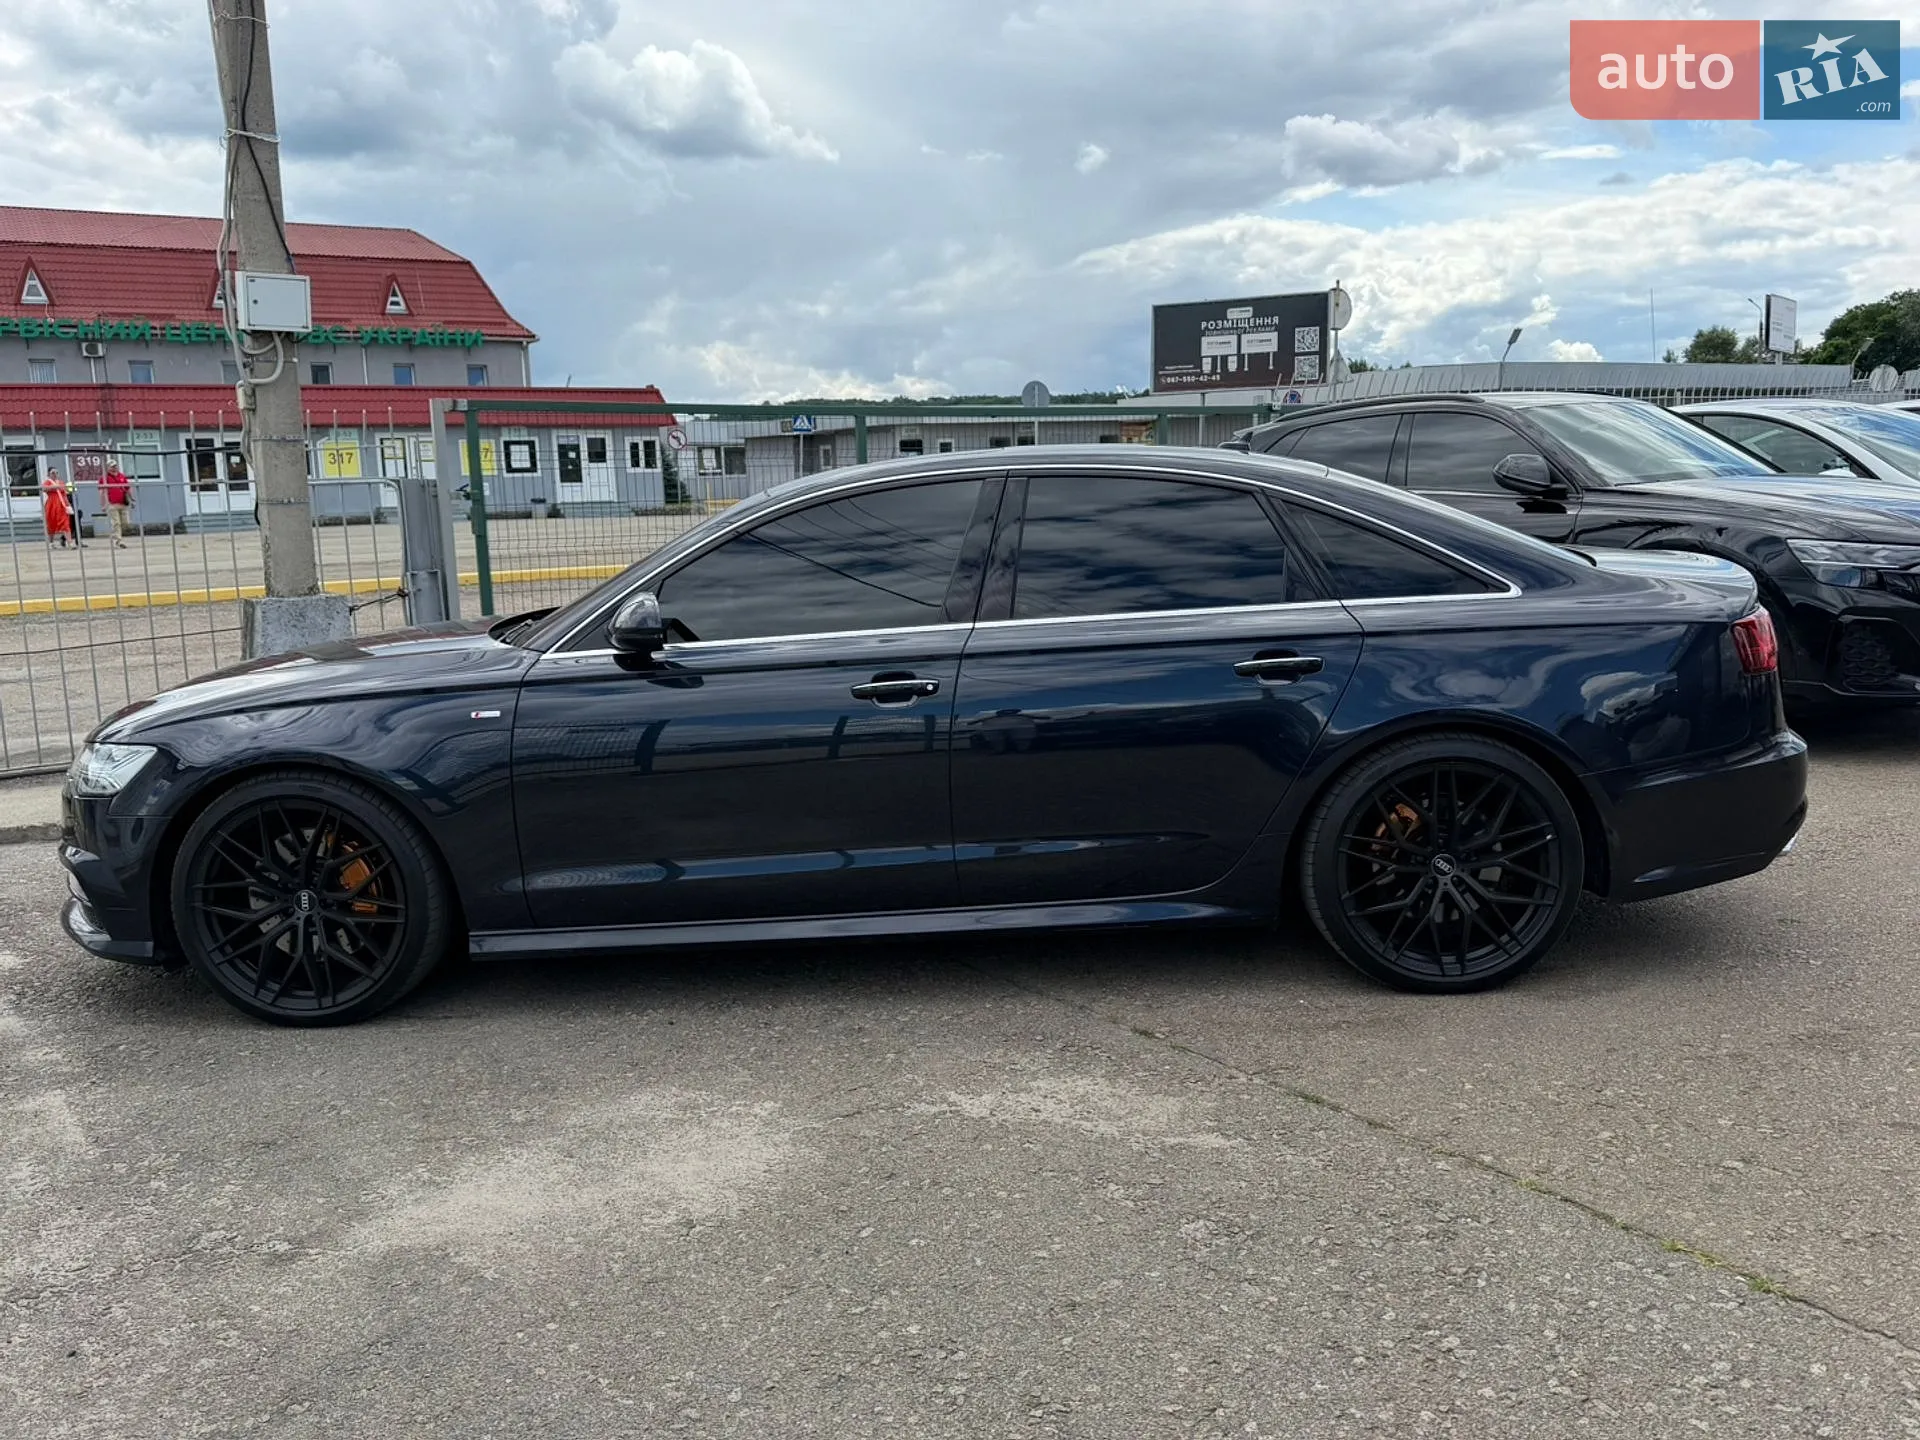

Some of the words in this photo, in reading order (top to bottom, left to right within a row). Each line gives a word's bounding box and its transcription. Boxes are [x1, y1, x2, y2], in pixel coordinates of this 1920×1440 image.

[1201, 316, 1279, 331] РОЗМІЩЕННЯ
[357, 322, 484, 348] УКРАЇНИ
[77, 456, 101, 467] 319
[328, 451, 354, 465] 317
